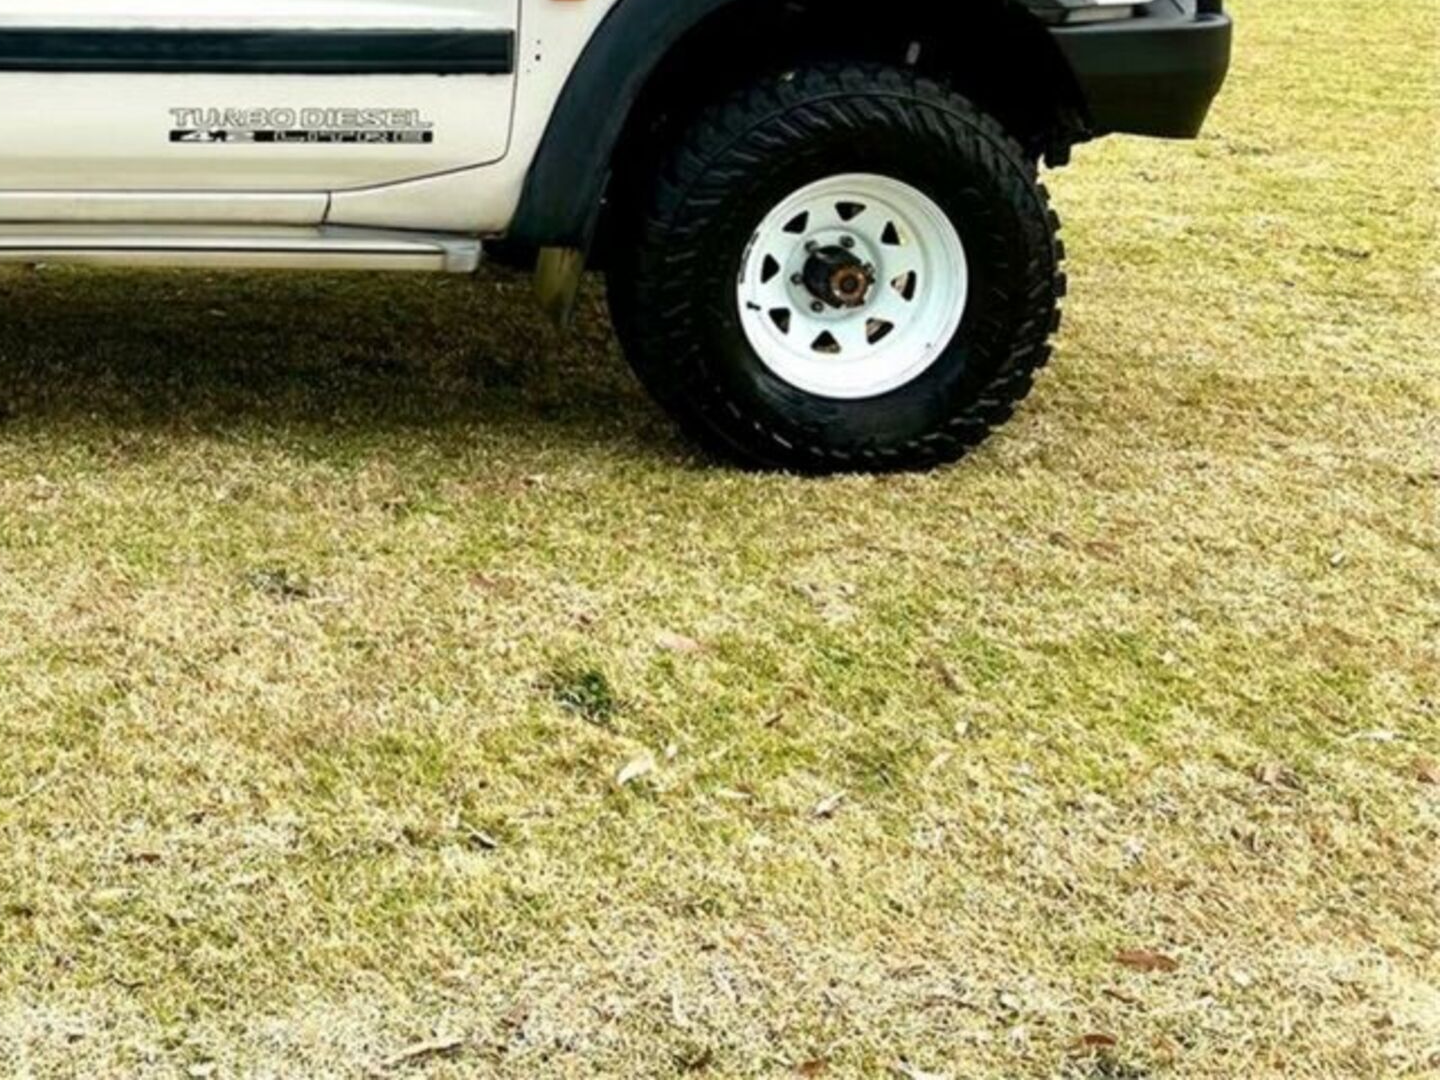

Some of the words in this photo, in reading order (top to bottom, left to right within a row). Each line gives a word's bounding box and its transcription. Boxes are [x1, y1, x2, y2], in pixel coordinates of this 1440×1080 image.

[169, 107, 296, 128] TURBO
[300, 107, 433, 128] DIESEL
[274, 130, 423, 143] LITRE
